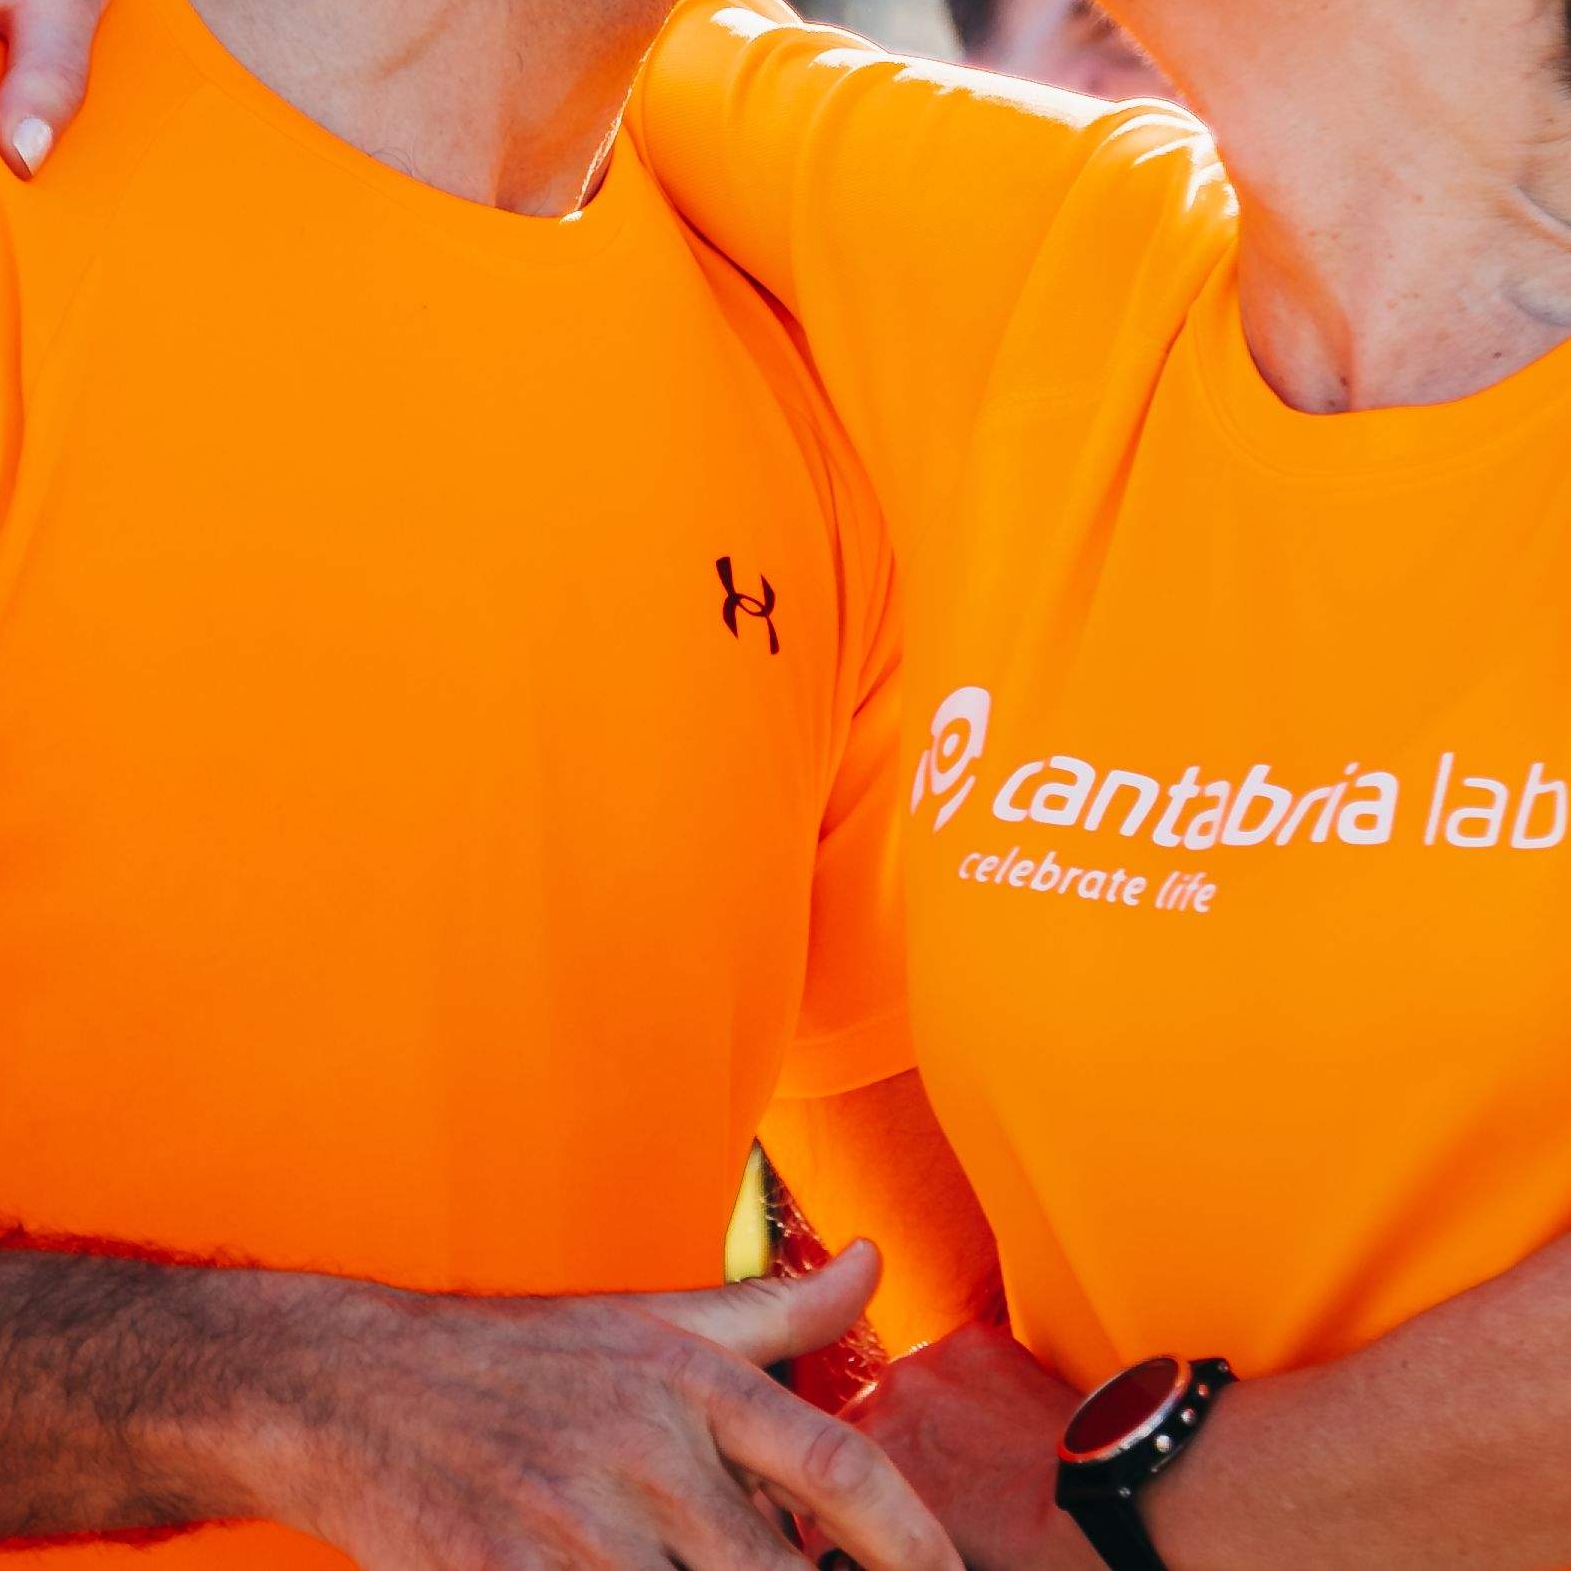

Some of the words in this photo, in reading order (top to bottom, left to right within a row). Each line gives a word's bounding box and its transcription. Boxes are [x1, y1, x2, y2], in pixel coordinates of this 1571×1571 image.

[991, 753, 1400, 850] cantabria
[957, 846, 1147, 907] celebrate
[1154, 870, 1218, 914] life
